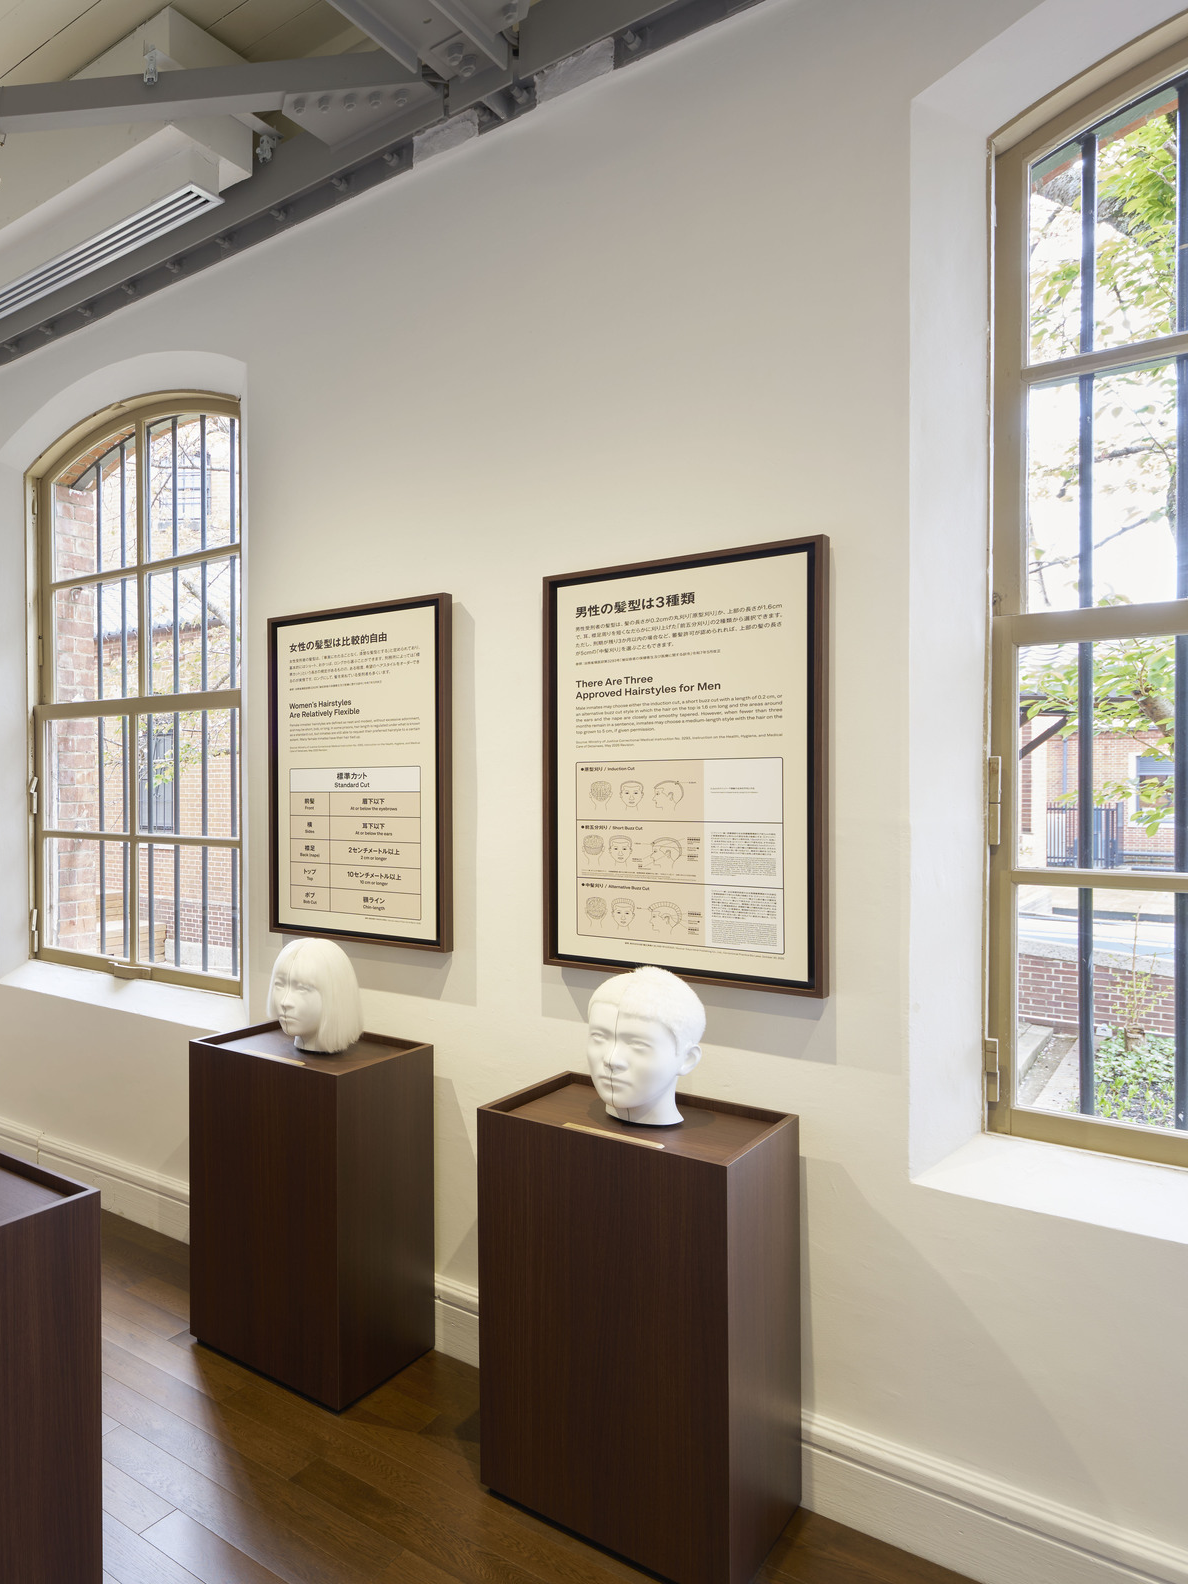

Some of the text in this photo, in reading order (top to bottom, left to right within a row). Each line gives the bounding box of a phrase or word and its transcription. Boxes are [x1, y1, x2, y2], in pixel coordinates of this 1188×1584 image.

[575, 591, 694, 618] 男性の髪型は3種類
[289, 631, 387, 652] 女性の髪型は比較的自由
[575, 674, 652, 688] There Are Three
[575, 681, 720, 701] Approved Hairstyles for Men
[289, 698, 351, 709] Women's Hairstyles
[301, 709, 332, 719] Relatively
[333, 707, 359, 715] Flexible
[348, 846, 399, 855] 2センチメートル以上
[347, 870, 401, 880] 10センチメートル以上
